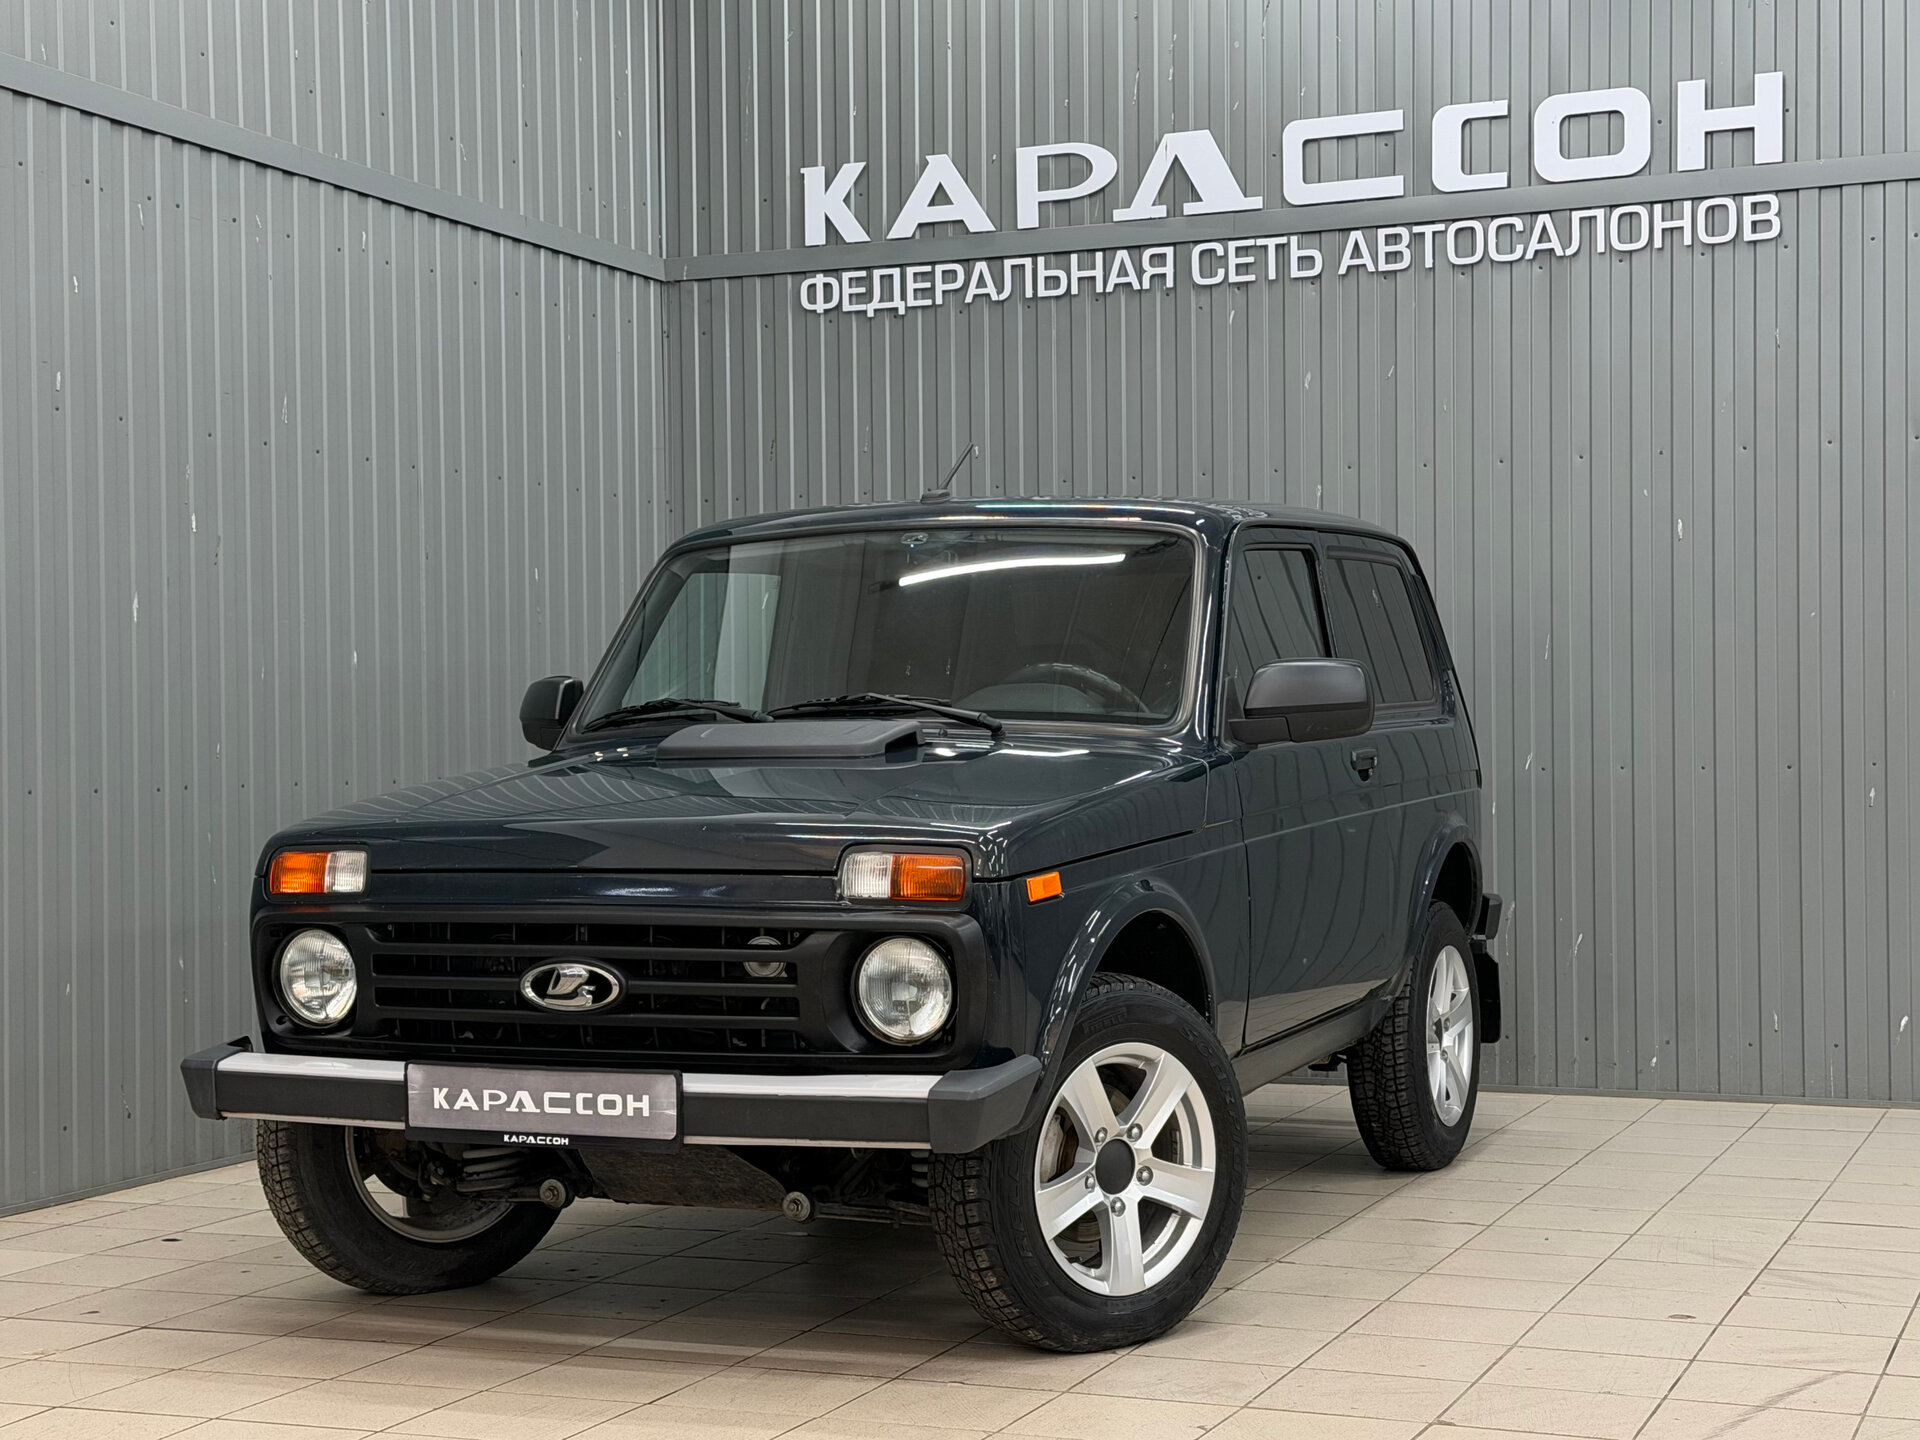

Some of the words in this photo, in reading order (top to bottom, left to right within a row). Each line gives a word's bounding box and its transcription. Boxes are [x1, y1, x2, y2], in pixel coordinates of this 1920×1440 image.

[799, 70, 1784, 246] КАРАССОН
[799, 246, 1175, 318] ФЕДЕРАЛЬНАЯ
[1191, 235, 1324, 286] СЕТЬ
[1337, 193, 1782, 276] АВТОСАЛОНОВ
[432, 1086, 651, 1117] КАРАССОН
[503, 1133, 570, 1146] КАРАССОН
